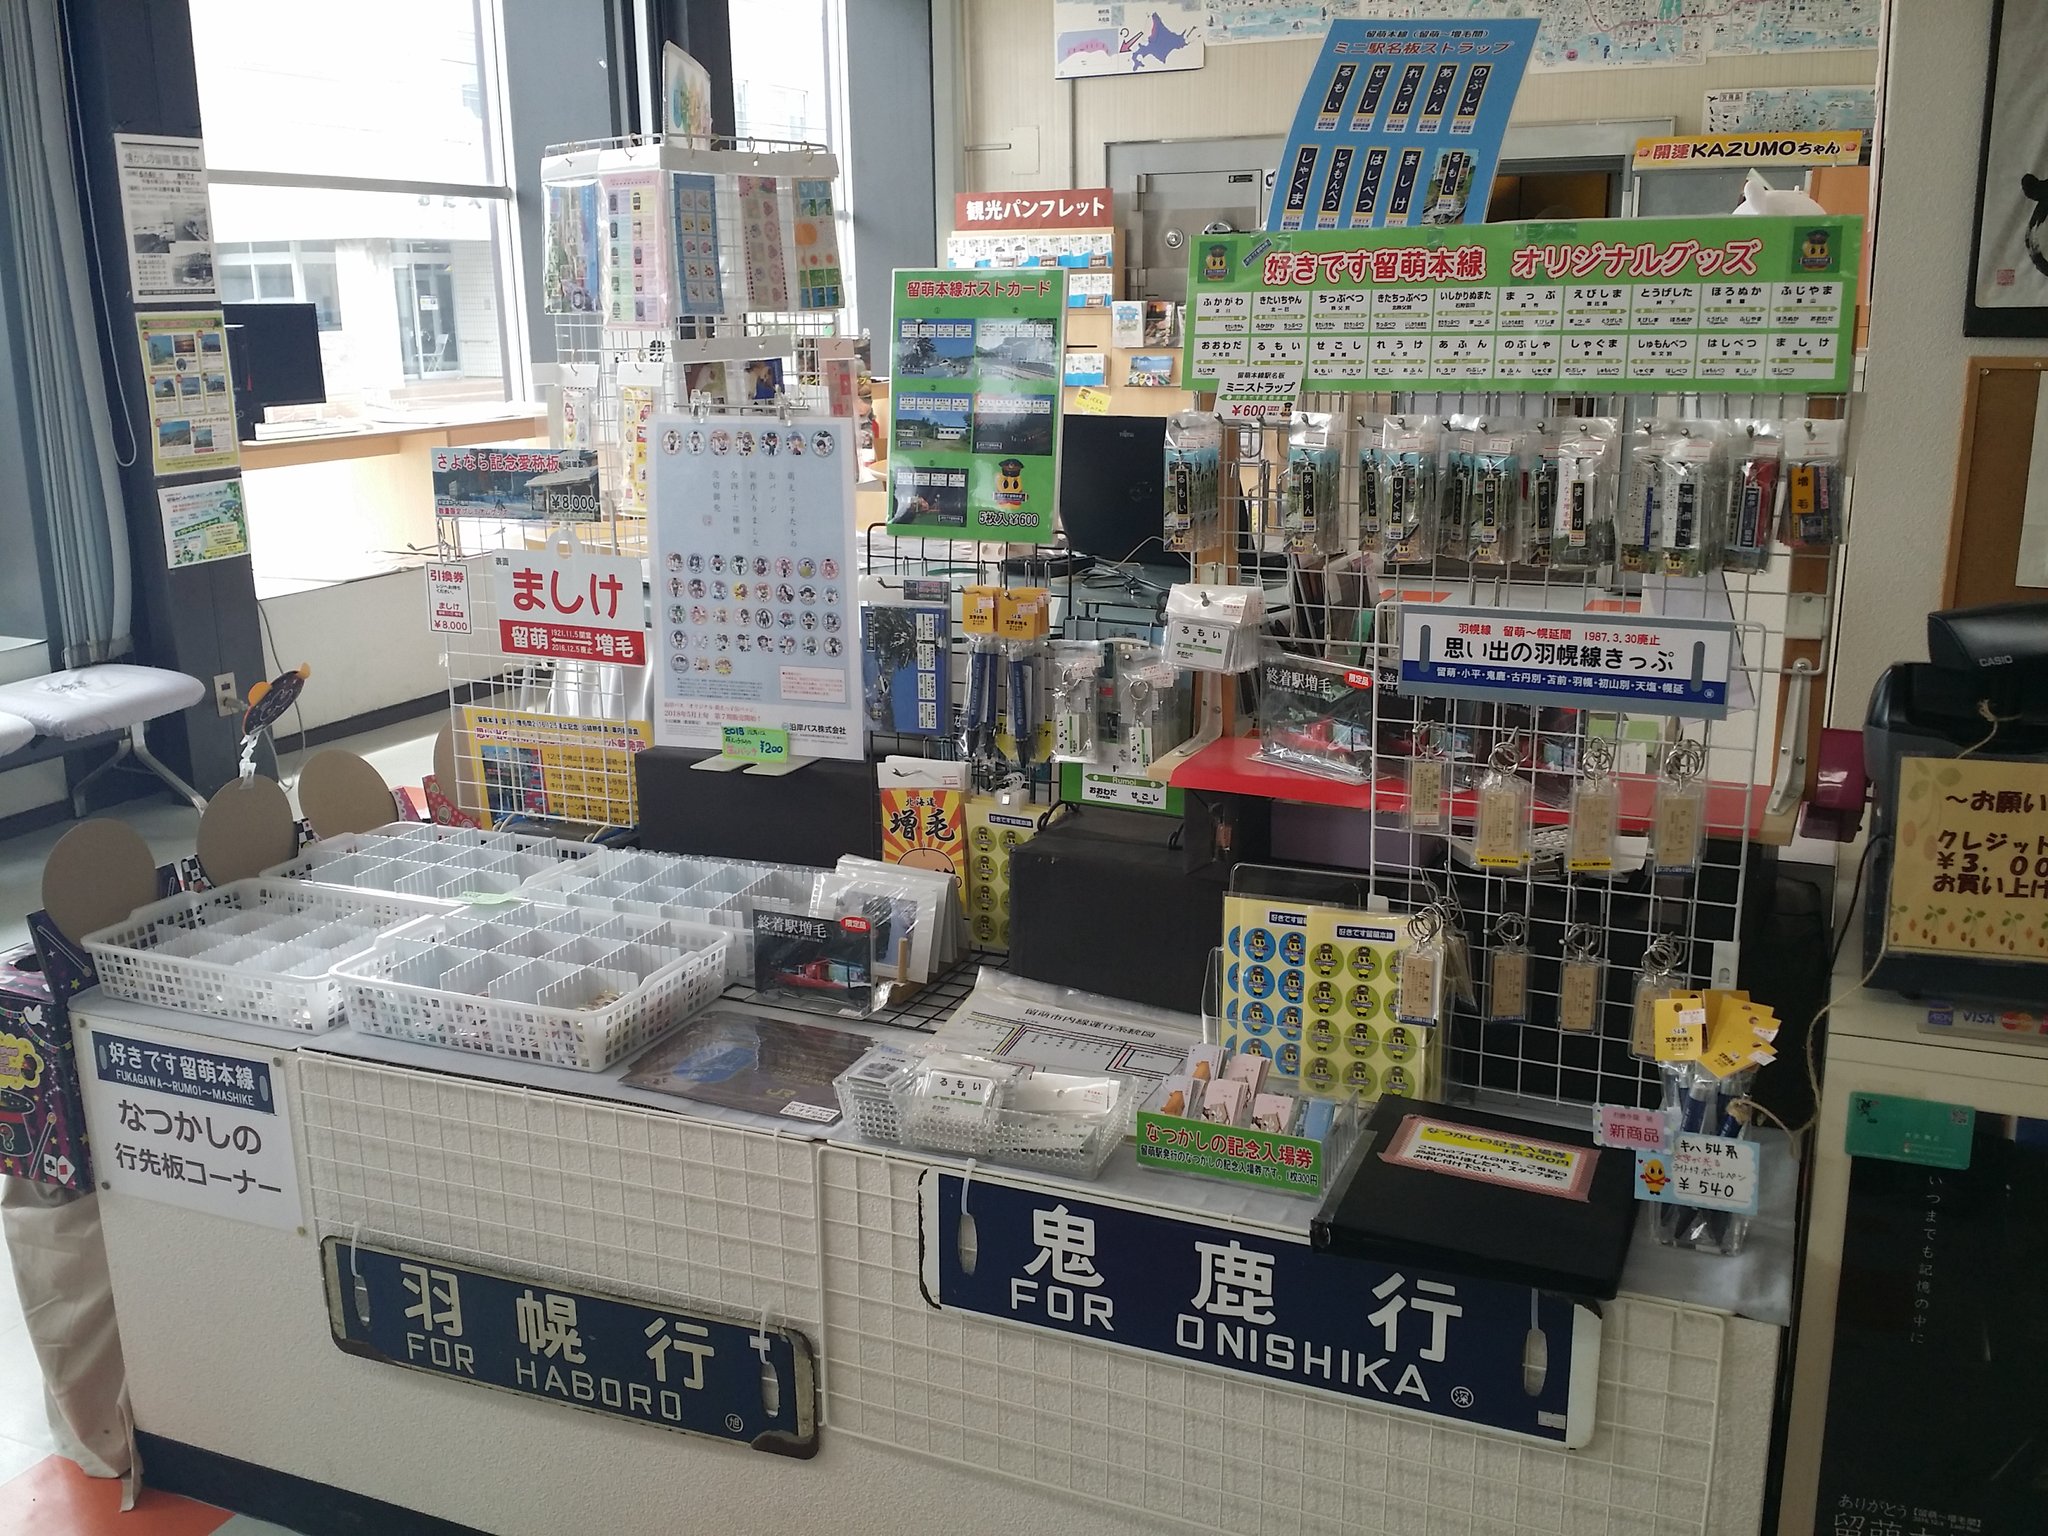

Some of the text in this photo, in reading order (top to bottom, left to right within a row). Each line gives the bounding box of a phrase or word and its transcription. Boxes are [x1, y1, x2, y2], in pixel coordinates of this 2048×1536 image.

[1333, 41, 1514, 55] ミニ駅名板ストラップ
[1327, 67, 1352, 110] るもい
[1363, 68, 1386, 110] せごし
[1397, 68, 1420, 112] れうけ
[1428, 68, 1453, 112] あふん
[1462, 67, 1487, 114] のぶしゃ
[1653, 139, 1840, 159] 開運KAZUMOちゃん
[1291, 152, 1313, 205] しゃぐま
[1325, 152, 1349, 209] しゅもんべつ
[1359, 153, 1383, 210] はしべつ
[1394, 154, 1418, 211] ましけ
[1444, 154, 1461, 193] るもい
[966, 197, 1105, 221] 観光パンフレット
[1263, 245, 1487, 287] 好きです留萌本線
[1511, 238, 1764, 279] オリジナルグッズ
[907, 281, 1051, 298] 留萌本線ポストカード
[1377, 293, 1428, 303] きたちっぷべつ
[1440, 291, 1491, 301] いしかりぬまた
[1506, 290, 1556, 300] まっぷ
[1574, 289, 1622, 299] えびしま
[1641, 288, 1693, 297] とうげした
[1711, 286, 1762, 296] ほろぬか
[1781, 286, 1833, 295] ふじやま
[1203, 297, 1244, 306] ふかがわ
[1319, 294, 1364, 304] ちっぷべつ
[1201, 341, 1242, 350] おおわだ
[1257, 342, 1301, 350] るもい
[1317, 341, 1361, 350] せごし
[1377, 340, 1423, 349] れうけ
[1439, 340, 1487, 349] あふん
[1505, 340, 1551, 348] のぶしゃ
[1571, 339, 1617, 348] しゃぐま
[1638, 339, 1687, 348] しゅもんべつ
[1707, 339, 1757, 348] はしべつ
[1776, 338, 1830, 347] ましけ
[1226, 382, 1296, 393] ミニストラップ
[1232, 404, 1267, 416] ¥600
[437, 453, 560, 473] さよなら記念愛称板
[1178, 473, 1188, 514] るもい
[1303, 472, 1314, 515] あふん
[1485, 481, 1495, 525] はしべつ
[1573, 486, 1584, 528] ましけ
[430, 569, 464, 582] 引換券
[513, 567, 623, 619] ましけ
[439, 602, 459, 610] ましけ
[511, 625, 549, 650] 留萌
[1182, 625, 1221, 639] るもい
[1459, 623, 1491, 635] 羽幌線
[594, 634, 635, 658] 増毛
[1444, 637, 1674, 672] 思い出の羽幌線きっぷ
[1979, 655, 2013, 667] CASIO
[1266, 667, 1332, 694] 終着駅増毛
[759, 740, 783, 754] ¥200
[1089, 787, 1117, 796] おおわだ
[1131, 792, 1159, 801] せごし
[905, 796, 937, 807] 北海道
[889, 808, 956, 842] 増毛
[757, 915, 827, 939] 終着駅増毛
[845, 919, 867, 930] 限定品
[1338, 928, 1394, 940] 好きです留萌本線
[1963, 1011, 1995, 1025] VISA
[108, 1041, 255, 1091] 好きです留萌本線
[940, 1077, 982, 1091] るもい
[119, 1099, 262, 1155] なつかしの
[1610, 1123, 1659, 1144] 新商品
[1145, 1121, 1314, 1169] なつかしの記念入場券
[1427, 1126, 1567, 1160] なつかしの記念入場券
[115, 1141, 281, 1194] 行先板コーナー
[1909, 1175, 1944, 1344] いつまでも記憶の中に
[1009, 1275, 1432, 1403] FOR ONISHIKA
[407, 1332, 683, 1422] FOR HABORO
[1839, 1494, 1907, 1518] ありがとう
